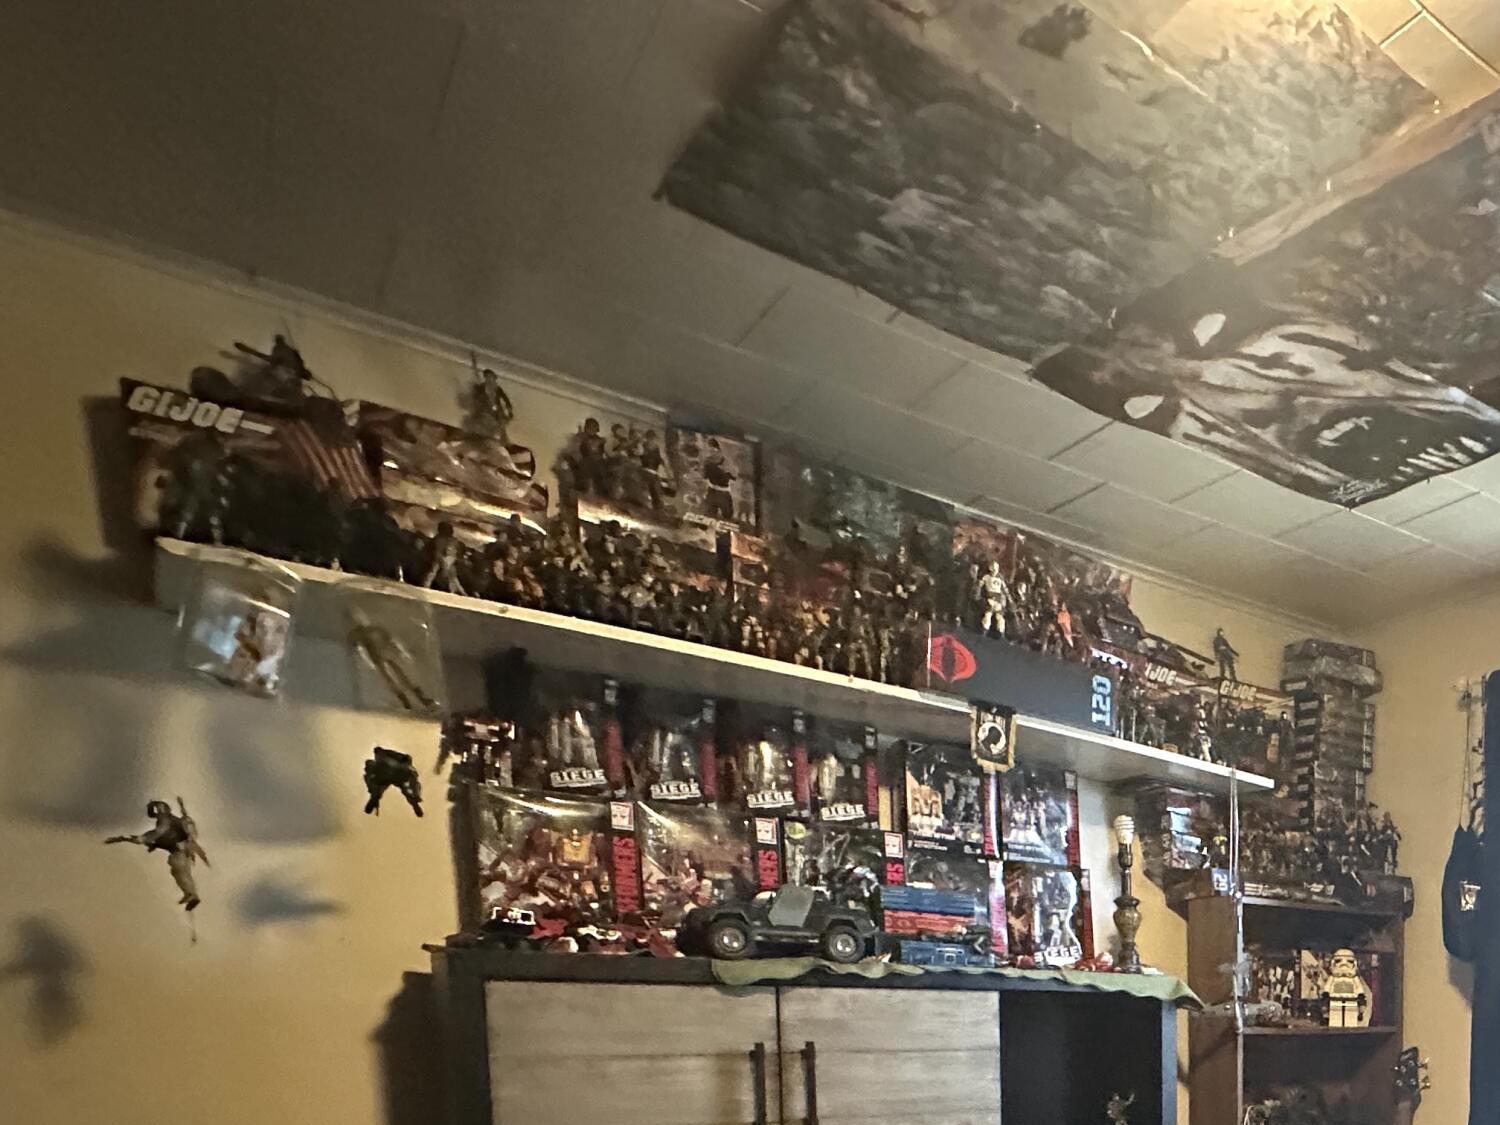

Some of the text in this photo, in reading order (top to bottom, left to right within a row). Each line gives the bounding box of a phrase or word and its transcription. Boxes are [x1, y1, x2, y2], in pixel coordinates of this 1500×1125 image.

[1091, 674, 1111, 727] 120
[550, 768, 605, 785] SIEGE
[650, 781, 700, 797] SIEGE
[746, 790, 794, 806] SIEGE
[821, 804, 865, 819] SIEGE
[1034, 945, 1081, 964] SIEGE
